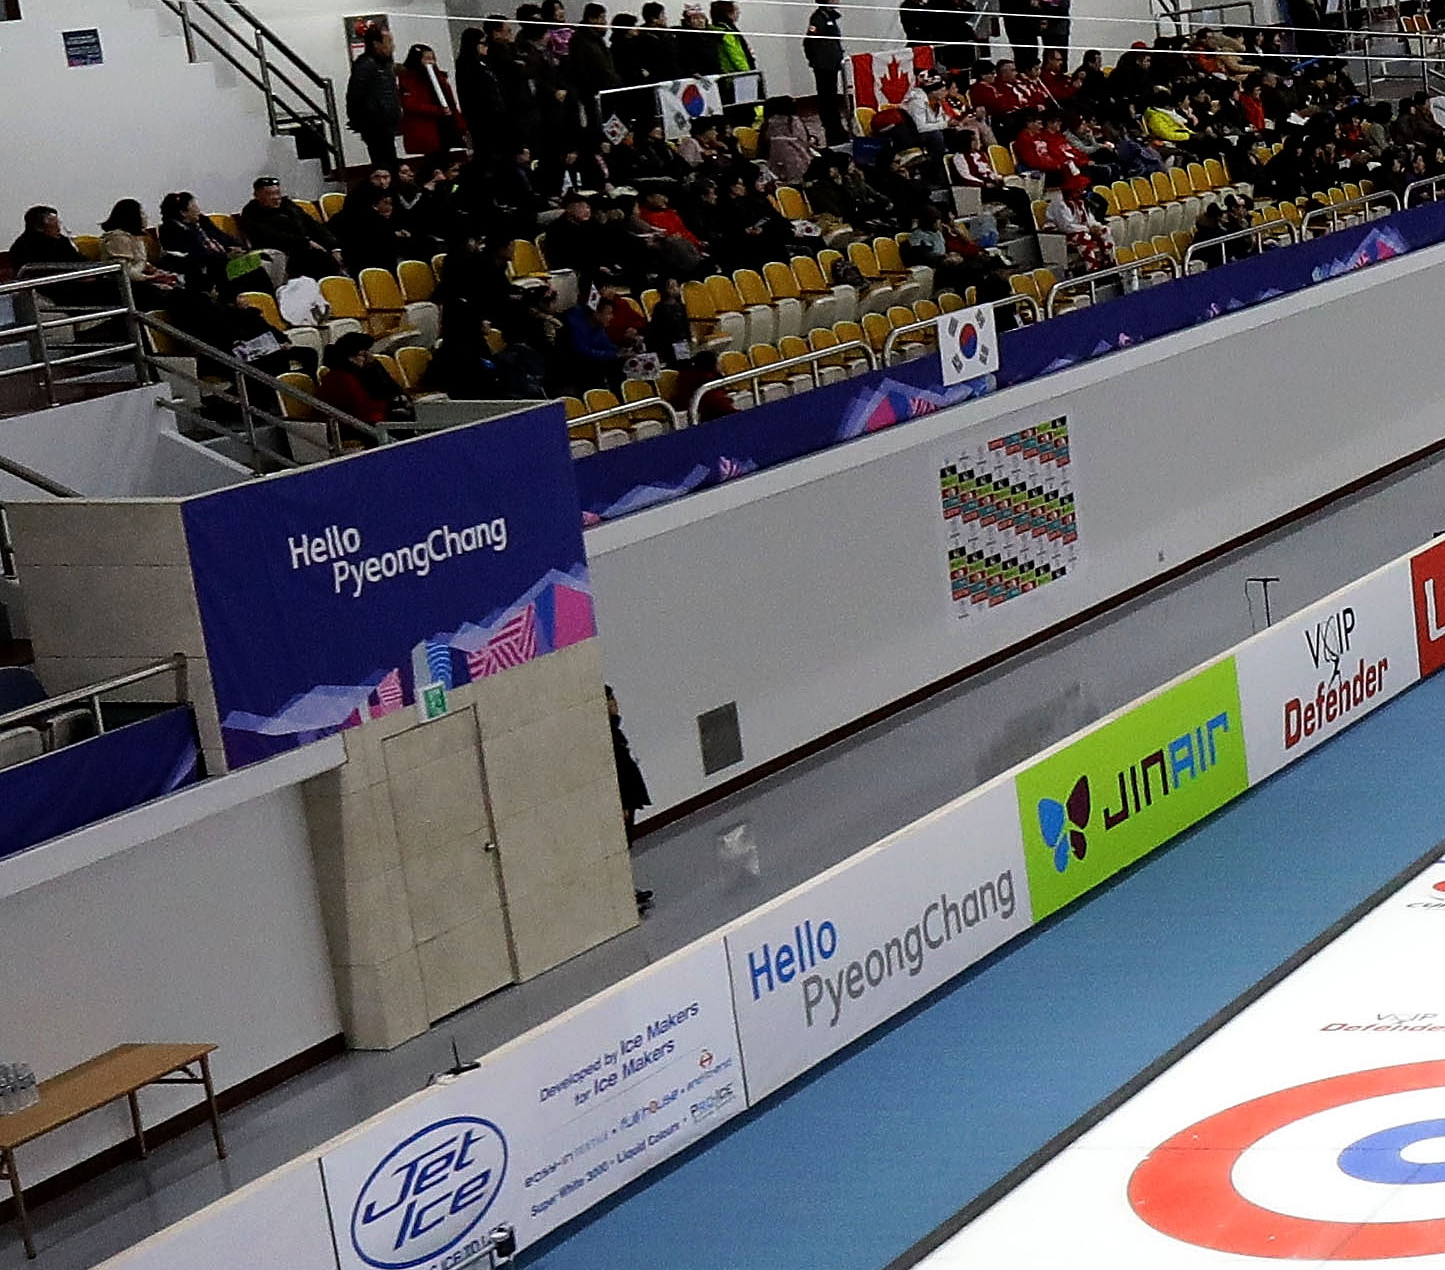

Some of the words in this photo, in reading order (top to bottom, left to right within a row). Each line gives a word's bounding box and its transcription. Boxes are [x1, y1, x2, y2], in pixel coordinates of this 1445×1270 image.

[288, 525, 361, 569] Hello
[332, 517, 508, 598] PyeongChang
[1284, 656, 1389, 751] Defender
[748, 918, 838, 1001] Hello
[801, 869, 1015, 1029] PyeongChang
[540, 1057, 602, 1104] Developed
[600, 1049, 619, 1073] by
[620, 1029, 646, 1056] Ice
[646, 1001, 700, 1042] Makers
[575, 1087, 593, 1108] for
[594, 1070, 620, 1099] Ice
[622, 1038, 676, 1080] Makers
